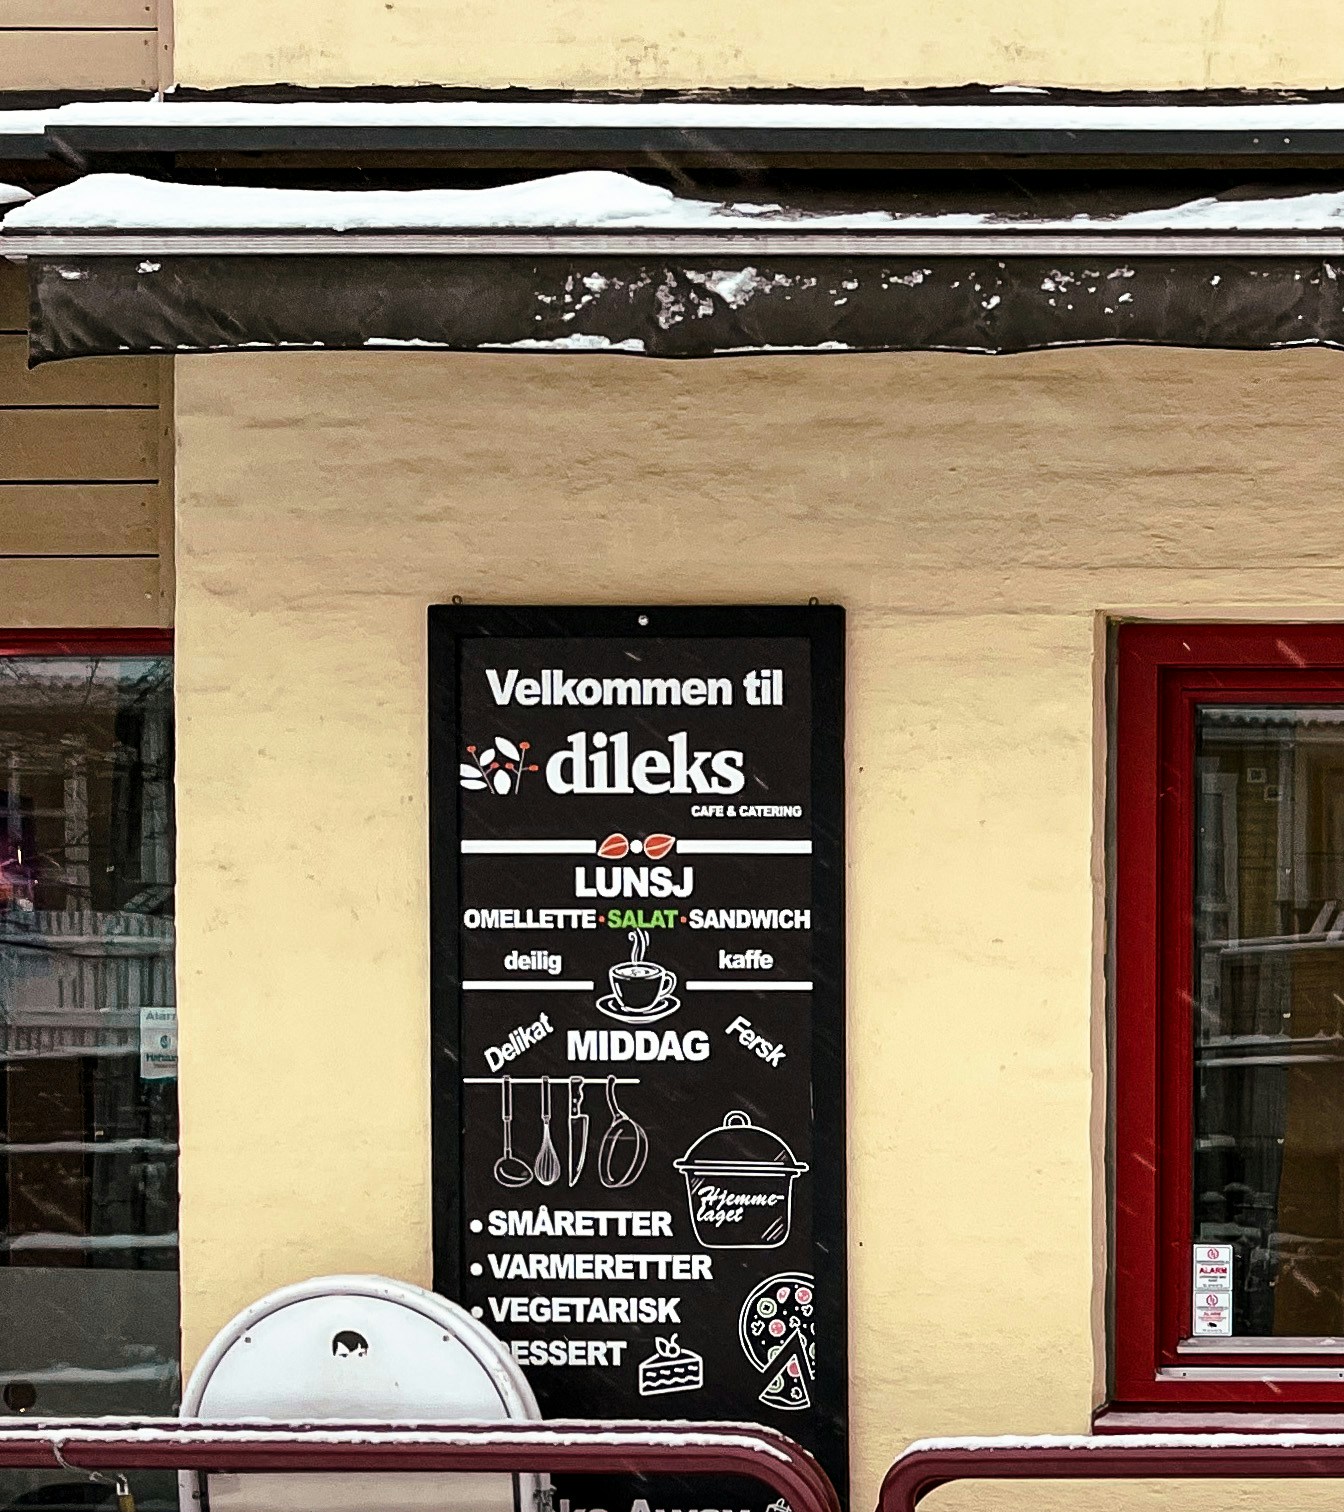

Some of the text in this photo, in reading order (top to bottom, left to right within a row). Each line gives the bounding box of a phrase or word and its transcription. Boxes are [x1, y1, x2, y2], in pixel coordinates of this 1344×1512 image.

[485, 669, 783, 706] Velkommen til
[545, 731, 745, 795] dileks
[691, 805, 802, 817] CAFE & CATERING
[575, 867, 694, 898] LUNSJ
[463, 909, 811, 930] OMELLETTE SALAT SANDWICH
[504, 951, 562, 975] deilig
[718, 950, 774, 971] kaffe
[483, 1011, 554, 1073] Delikat
[567, 1030, 710, 1062] MIDDAG
[724, 1015, 788, 1068] Fersk
[487, 1205, 673, 1237] SMÅRETTER
[696, 1206, 744, 1228] laget
[487, 1253, 713, 1280] VARMERETTER
[487, 1296, 681, 1324] VEGETARISK
